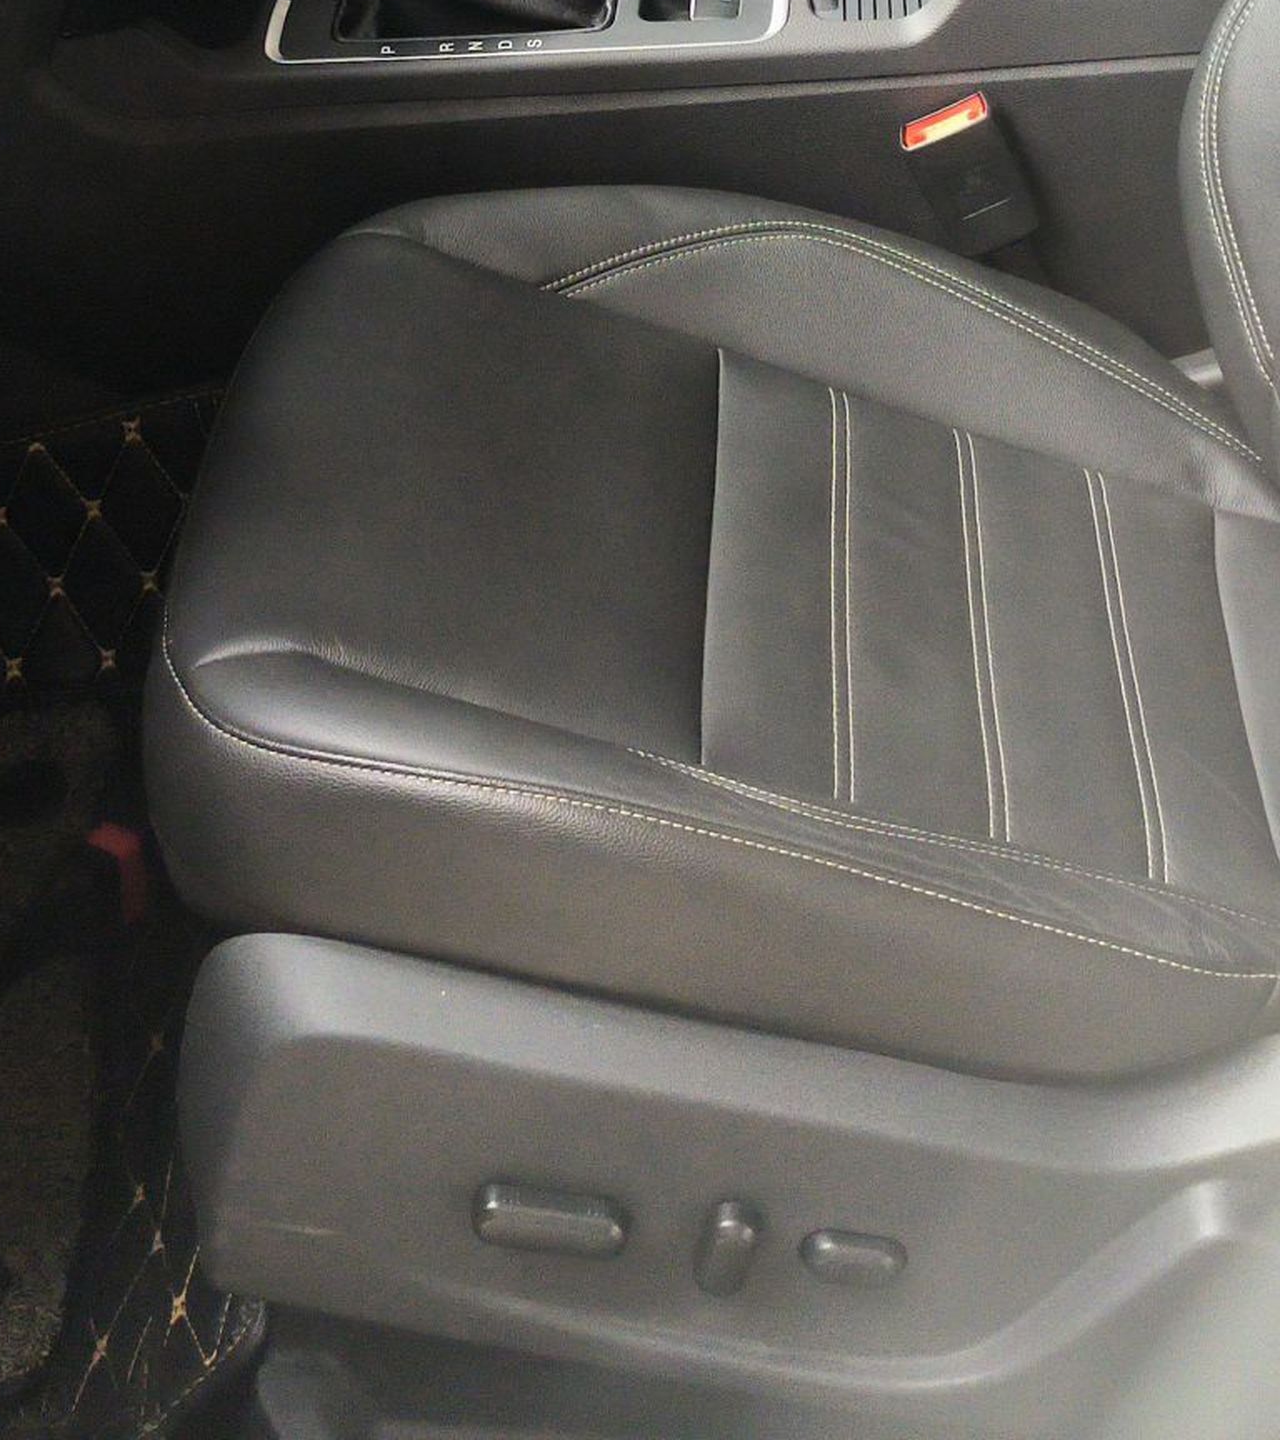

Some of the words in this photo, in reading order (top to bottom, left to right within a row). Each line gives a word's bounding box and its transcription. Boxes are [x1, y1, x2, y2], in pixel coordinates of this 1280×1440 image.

[381, 45, 396, 55] P
[439, 42, 455, 53] R
[468, 40, 484, 51] N
[498, 39, 513, 50] D
[527, 38, 543, 49] S
